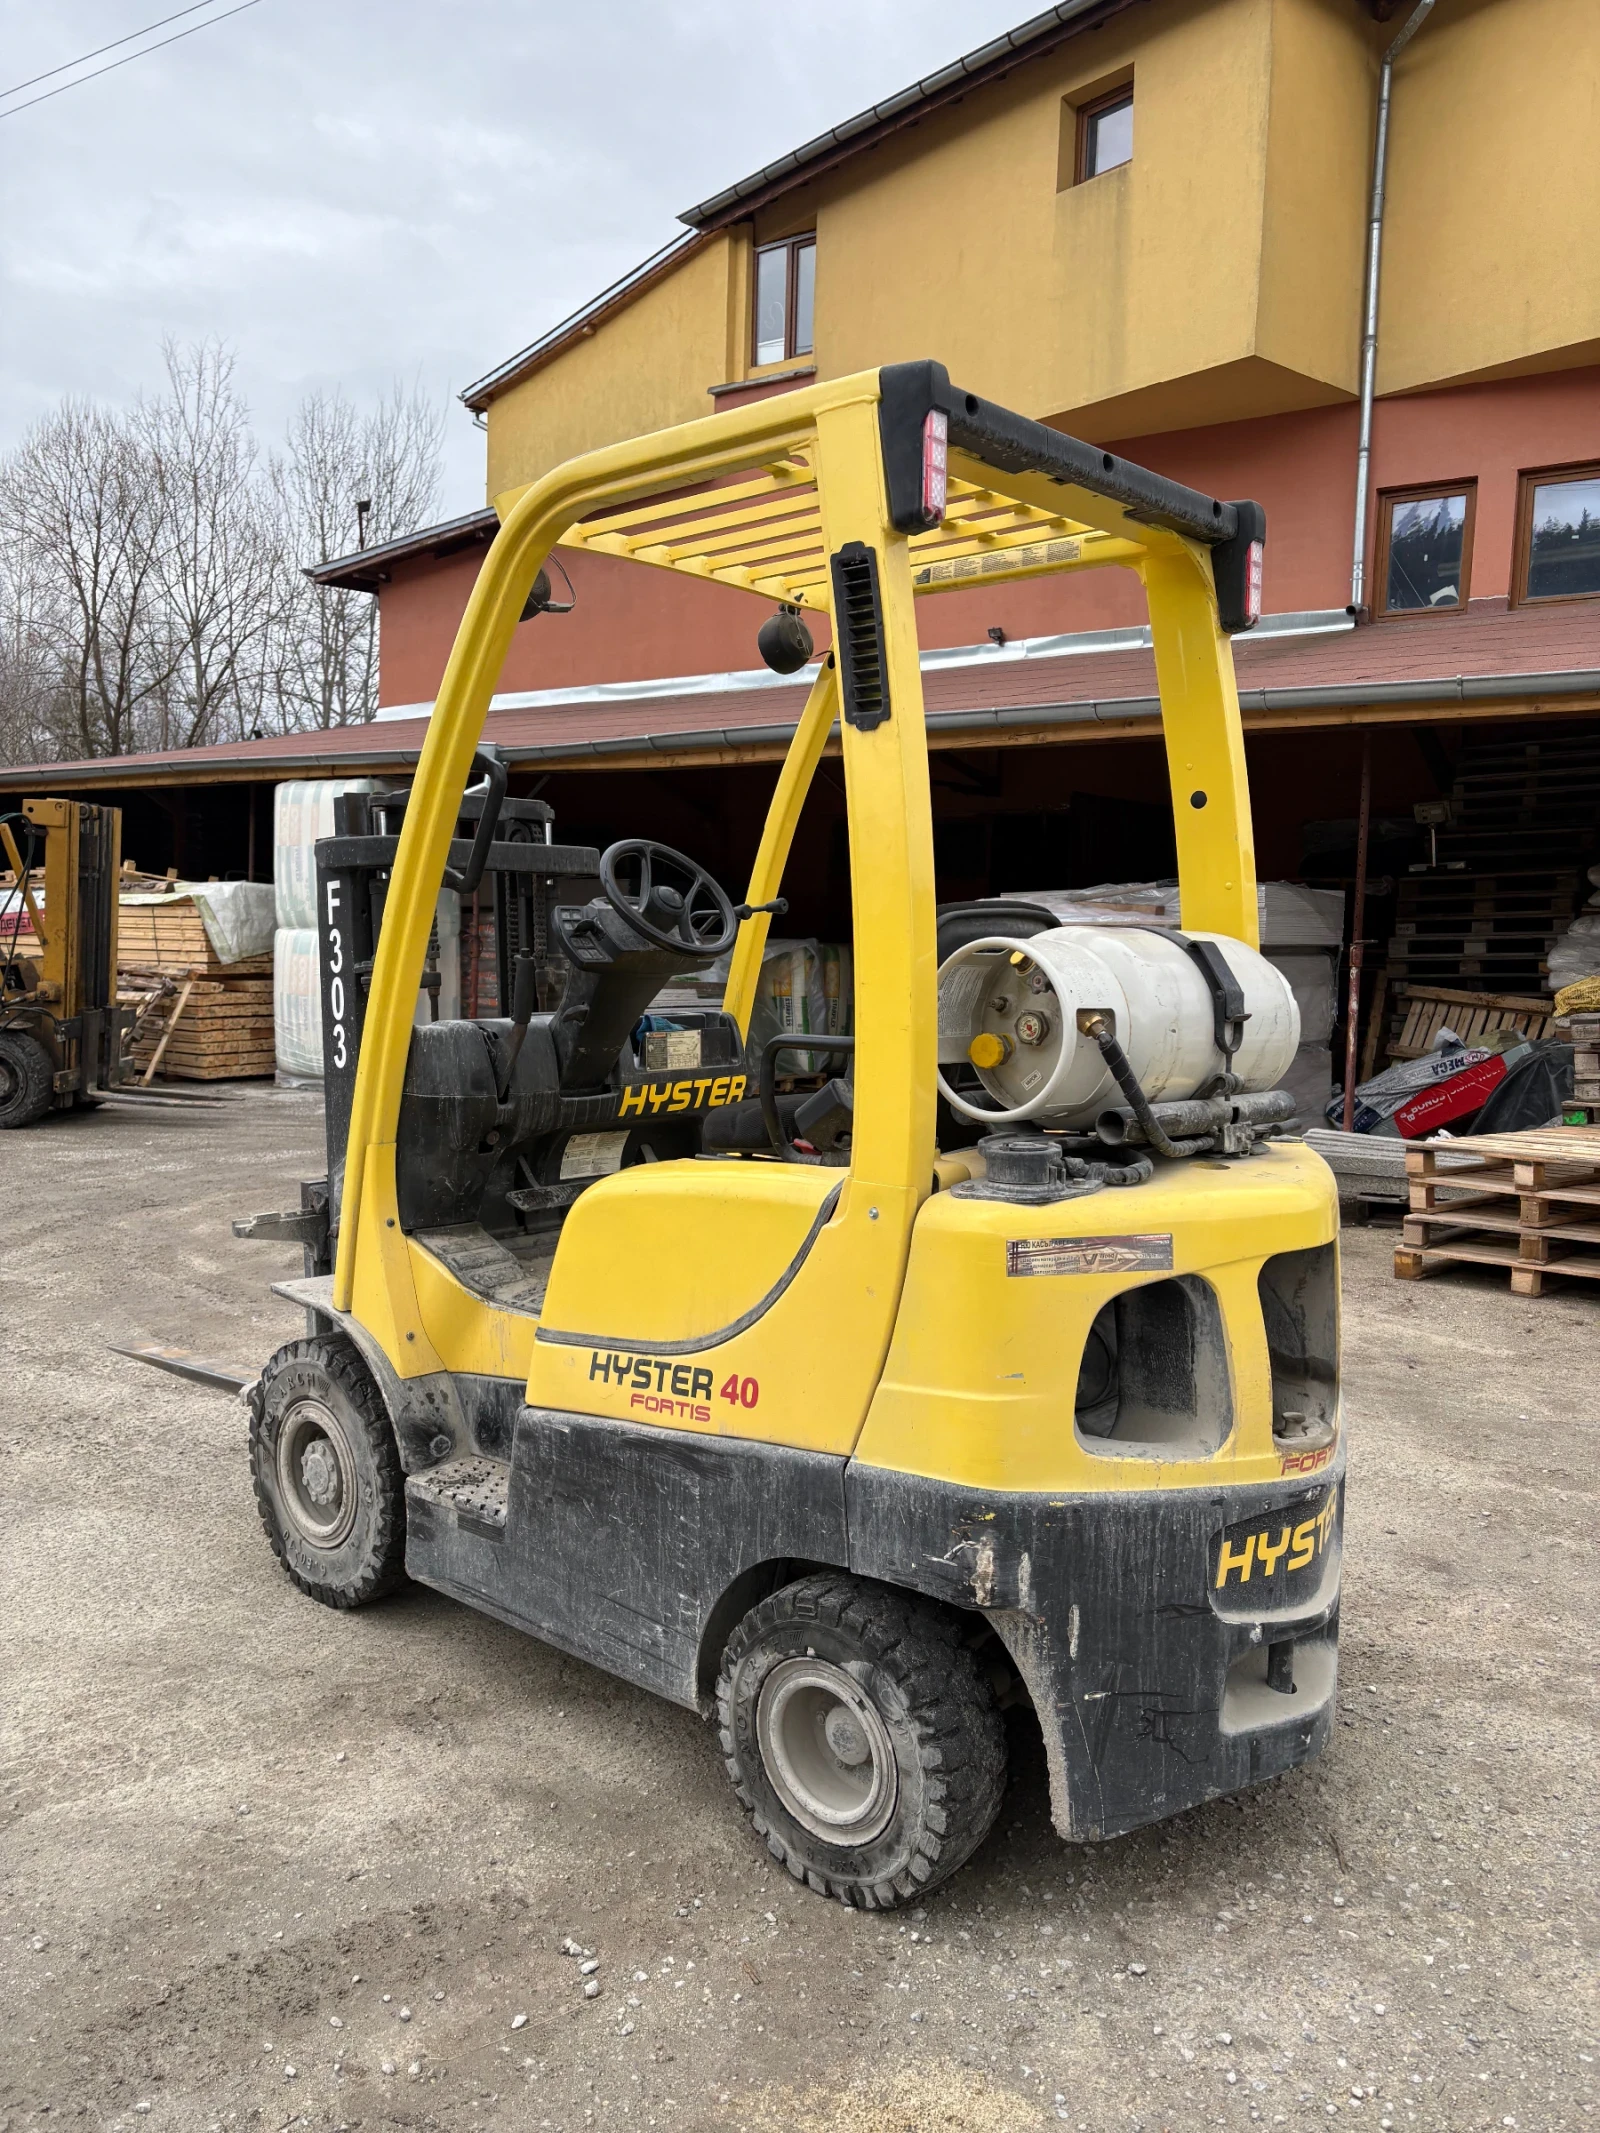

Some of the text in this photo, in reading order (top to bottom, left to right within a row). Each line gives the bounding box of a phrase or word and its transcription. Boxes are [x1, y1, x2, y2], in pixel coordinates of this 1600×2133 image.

[326, 879, 347, 1069] F303
[617, 1074, 748, 1117] HYSTER
[1431, 1056, 1466, 1077] MEGA
[262, 1371, 316, 1441] MONARCH
[589, 1351, 759, 1409] HYSTER 40
[630, 1393, 711, 1422] FORTIS
[1215, 1488, 1337, 1589] HYSTER
